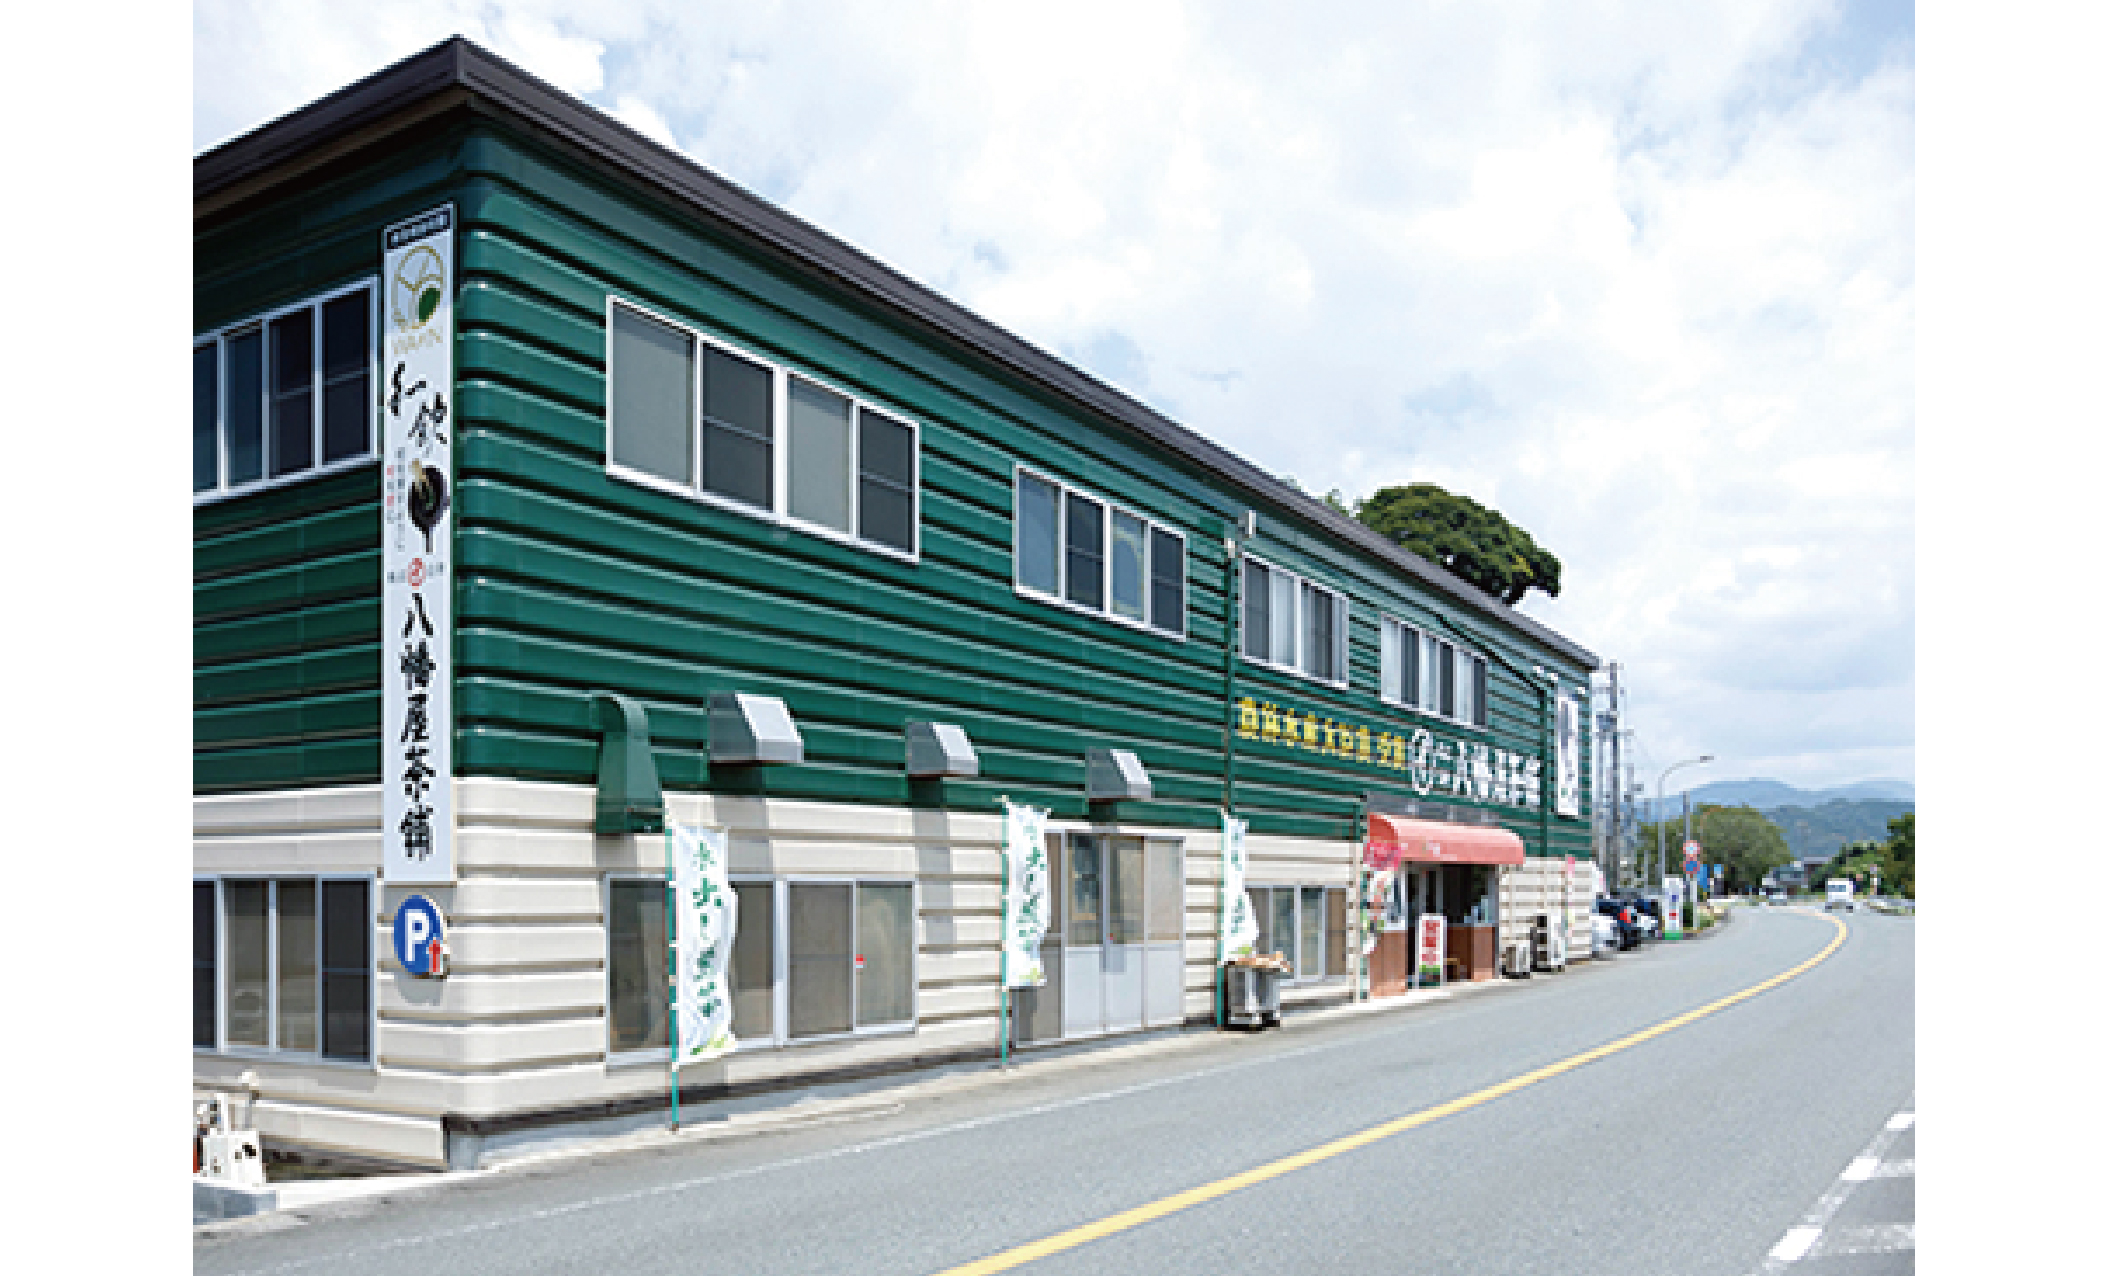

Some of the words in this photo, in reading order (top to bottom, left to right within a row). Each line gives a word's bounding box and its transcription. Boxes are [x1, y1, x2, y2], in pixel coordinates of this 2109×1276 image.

[398, 592, 436, 861] 八幡屋茶舗
[404, 908, 430, 962] P
